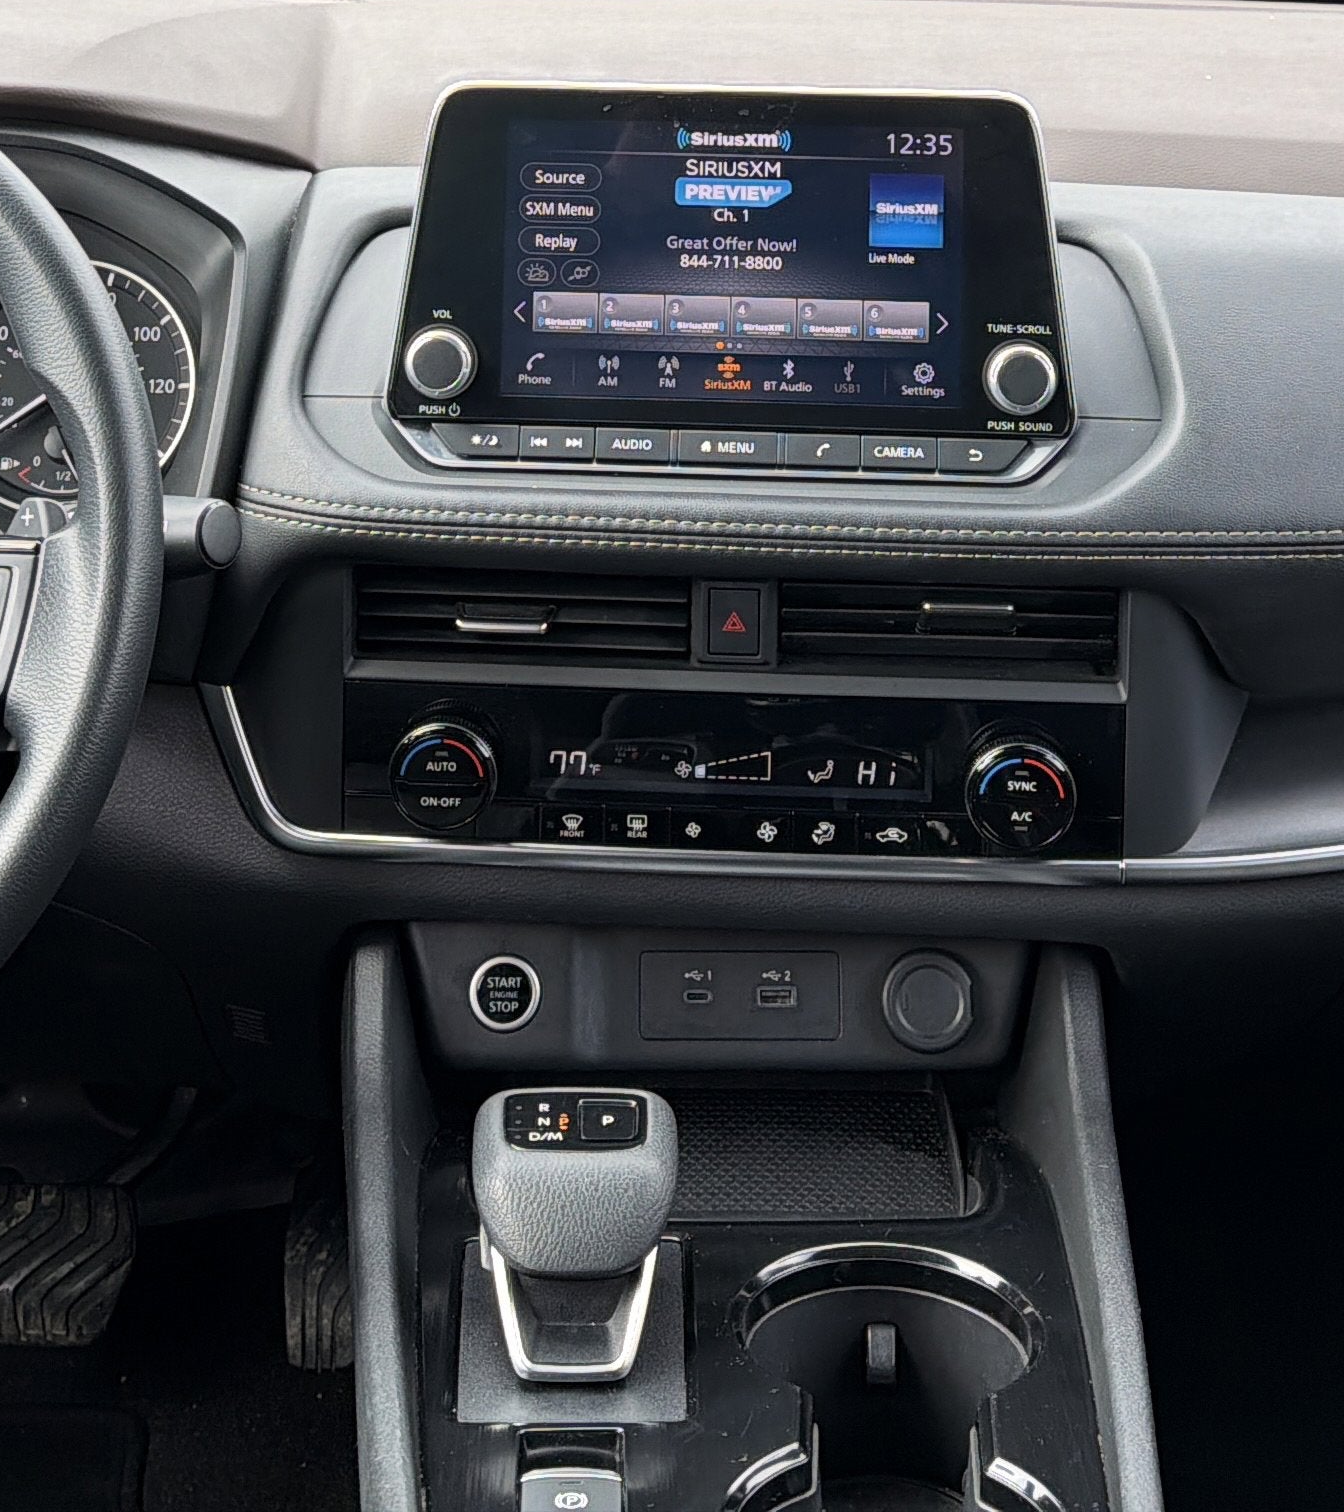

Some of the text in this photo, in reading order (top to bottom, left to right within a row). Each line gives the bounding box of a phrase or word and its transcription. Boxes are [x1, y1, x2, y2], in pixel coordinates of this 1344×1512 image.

[885, 132, 954, 156] 12:35
[684, 159, 782, 178] SIRIUSXM
[534, 169, 586, 185] Source
[684, 183, 783, 201] PREVIEW
[525, 201, 594, 217] SXM Menu
[875, 202, 939, 216] SiriusXM
[713, 208, 750, 223] Ch. 1
[534, 233, 578, 252] Replay
[666, 235, 798, 253] Great Offer Now!
[679, 253, 783, 271] 844-711-8800
[868, 252, 915, 265] Live Mode
[540, 299, 548, 310] 1
[605, 300, 615, 312] 2
[671, 302, 681, 314] 3
[737, 304, 747, 316] 4
[432, 309, 453, 320] VOL
[804, 306, 813, 318] 5
[870, 307, 880, 319] 6
[133, 326, 162, 342] 100
[517, 373, 552, 386] Phone
[597, 376, 619, 387] AM
[659, 377, 676, 388] FM
[704, 379, 752, 391] SiriusXM
[147, 378, 176, 395] 120
[763, 381, 813, 393] BT Audio
[834, 383, 861, 394] USB1
[900, 385, 946, 399] Settings
[1, 396, 14, 407] 20
[418, 405, 446, 415] PUSH
[986, 420, 1053, 433] PUSH SOUND
[611, 439, 653, 451] AUDIO
[716, 441, 755, 455] MENU
[873, 445, 925, 459] CAMERA
[55, 470, 72, 482] 1/2
[425, 761, 457, 773] AUTO
[1007, 780, 1038, 792] SYNC
[419, 796, 462, 808] ON-OFF
[1010, 811, 1034, 823] A/C
[559, 829, 585, 839] FRONT
[626, 830, 649, 839] REAR
[783, 969, 792, 982] 2
[486, 976, 523, 989] START
[489, 990, 519, 1000] ENGINE
[488, 1000, 520, 1014] STOP
[538, 1102, 551, 1113] R
[537, 1116, 552, 1127] N
[601, 1114, 616, 1127] P
[528, 1131, 565, 1142] D/M
